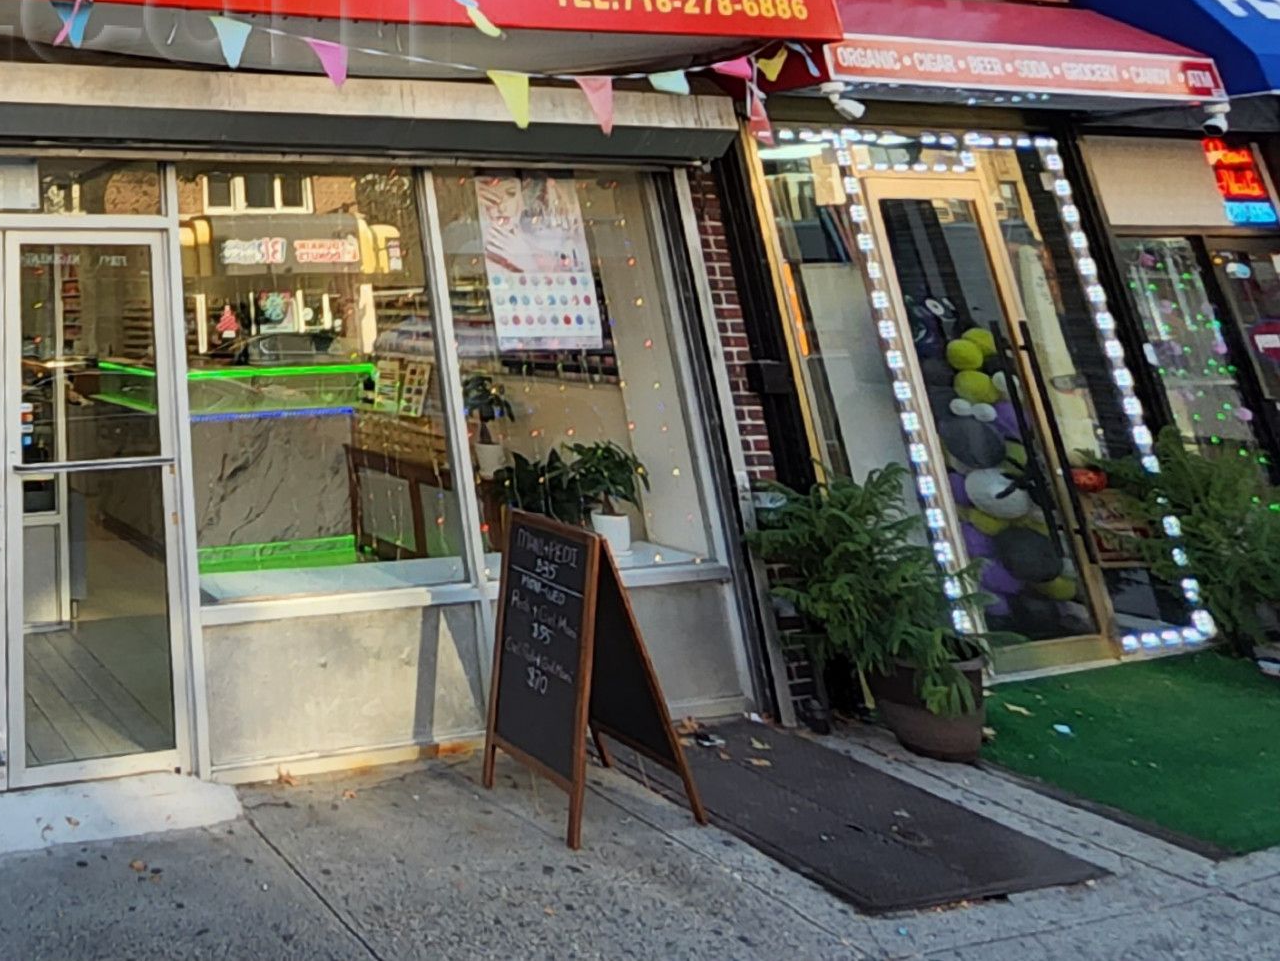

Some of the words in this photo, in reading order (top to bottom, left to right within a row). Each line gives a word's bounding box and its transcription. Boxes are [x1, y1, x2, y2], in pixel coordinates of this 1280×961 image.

[836, 46, 901, 71] ORGANIC
[912, 51, 959, 74] CIGAR
[967, 55, 1006, 76] BEER
[1014, 58, 1054, 80] SODA
[1061, 61, 1120, 83] GROCERY
[1128, 65, 1171, 86] CANDY
[1186, 69, 1215, 88] ATM
